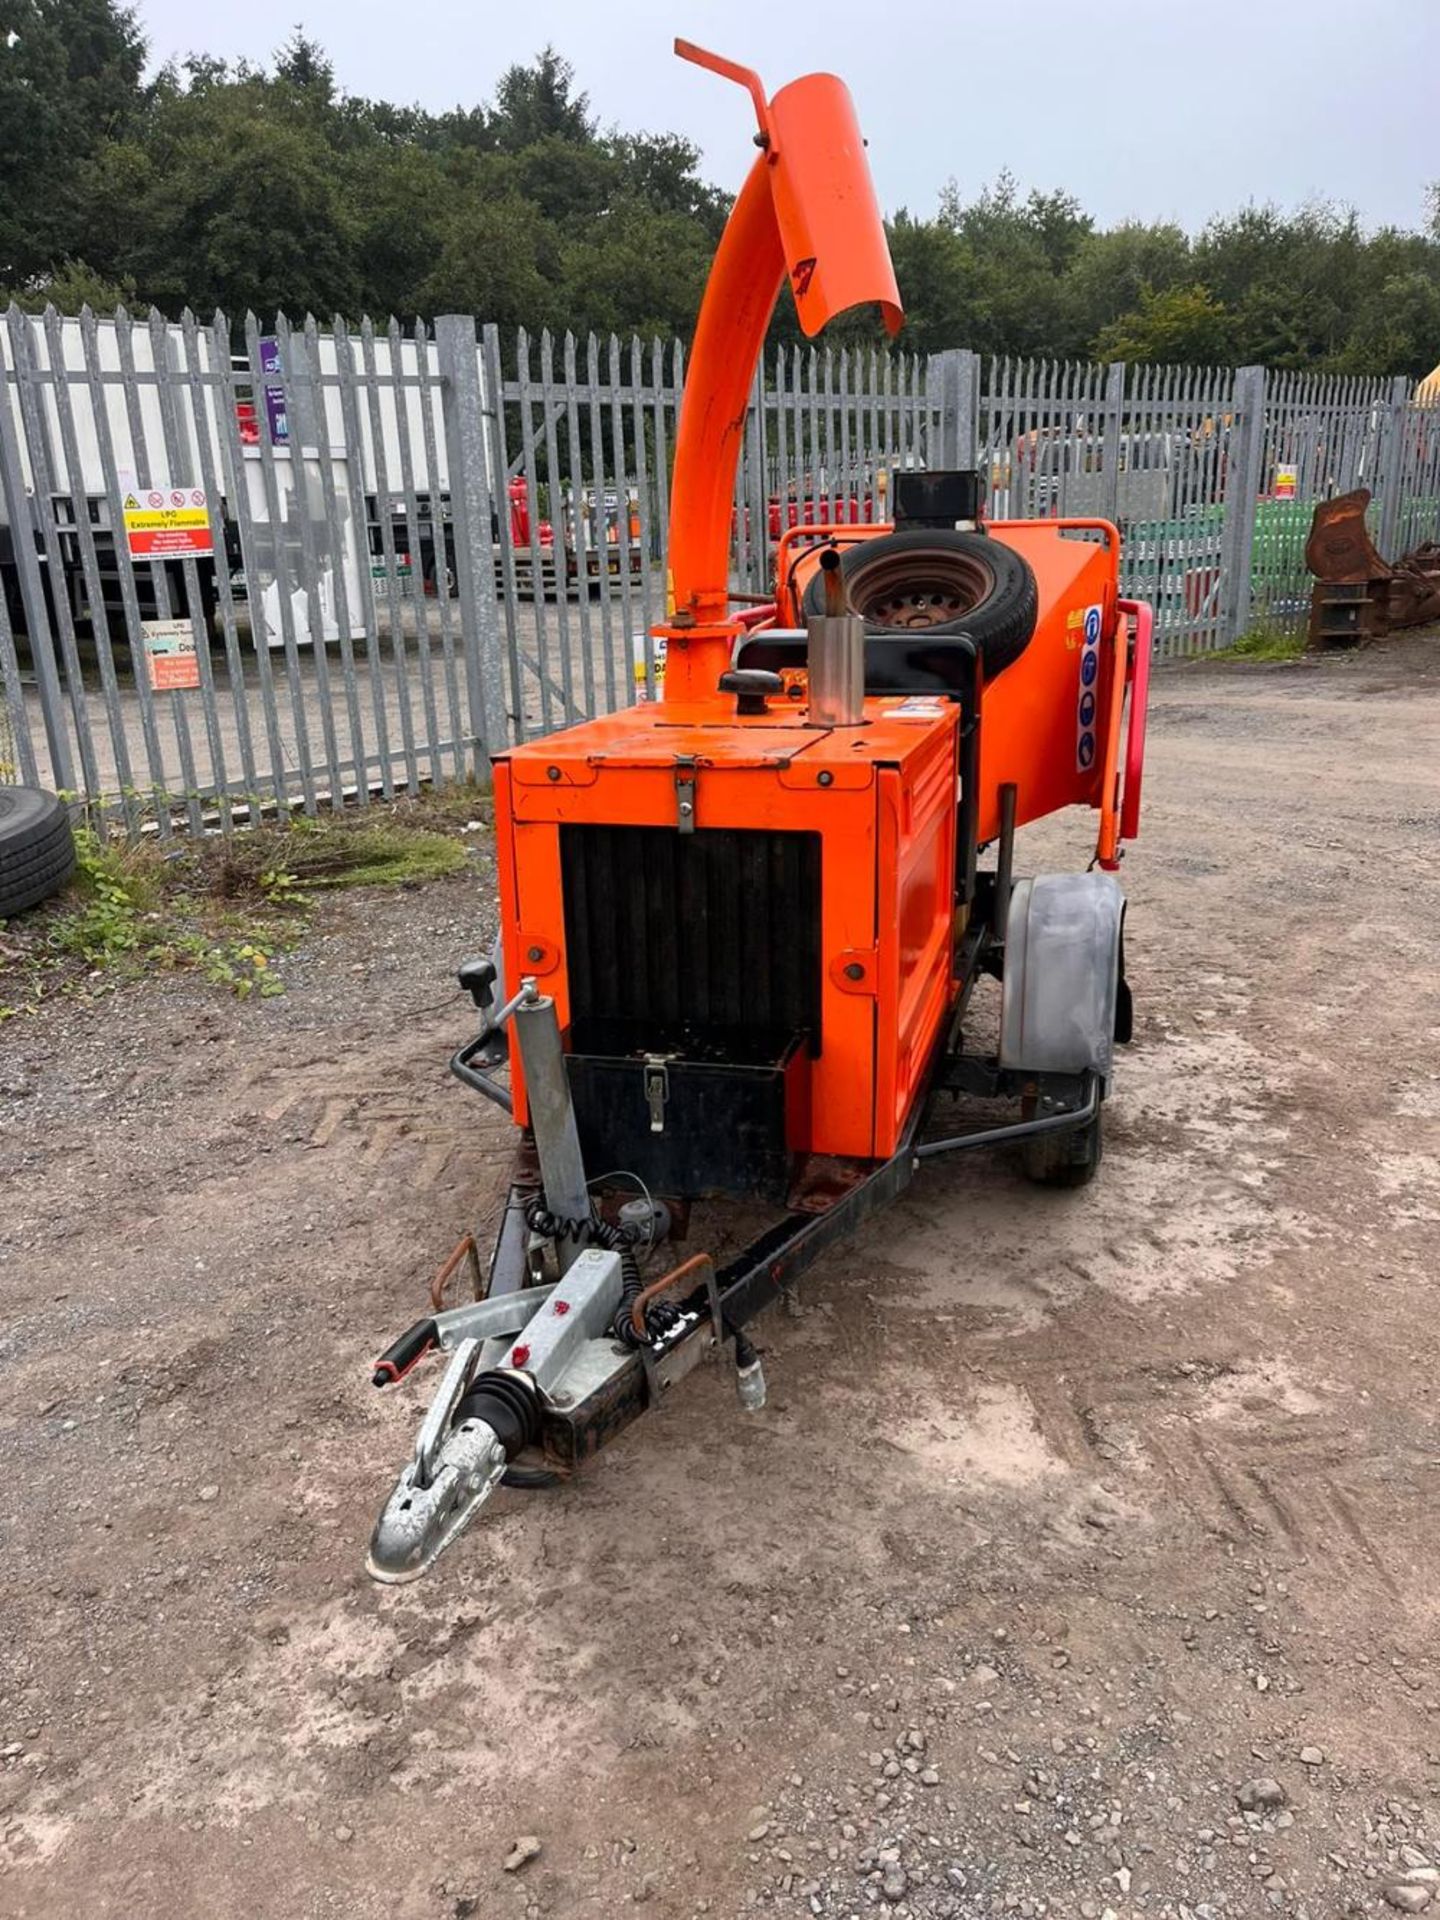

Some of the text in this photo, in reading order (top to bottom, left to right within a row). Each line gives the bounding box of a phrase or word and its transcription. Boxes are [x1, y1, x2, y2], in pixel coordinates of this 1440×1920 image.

[160, 510, 177, 519] LPG
[131, 519, 206, 529] Extremely Flammable
